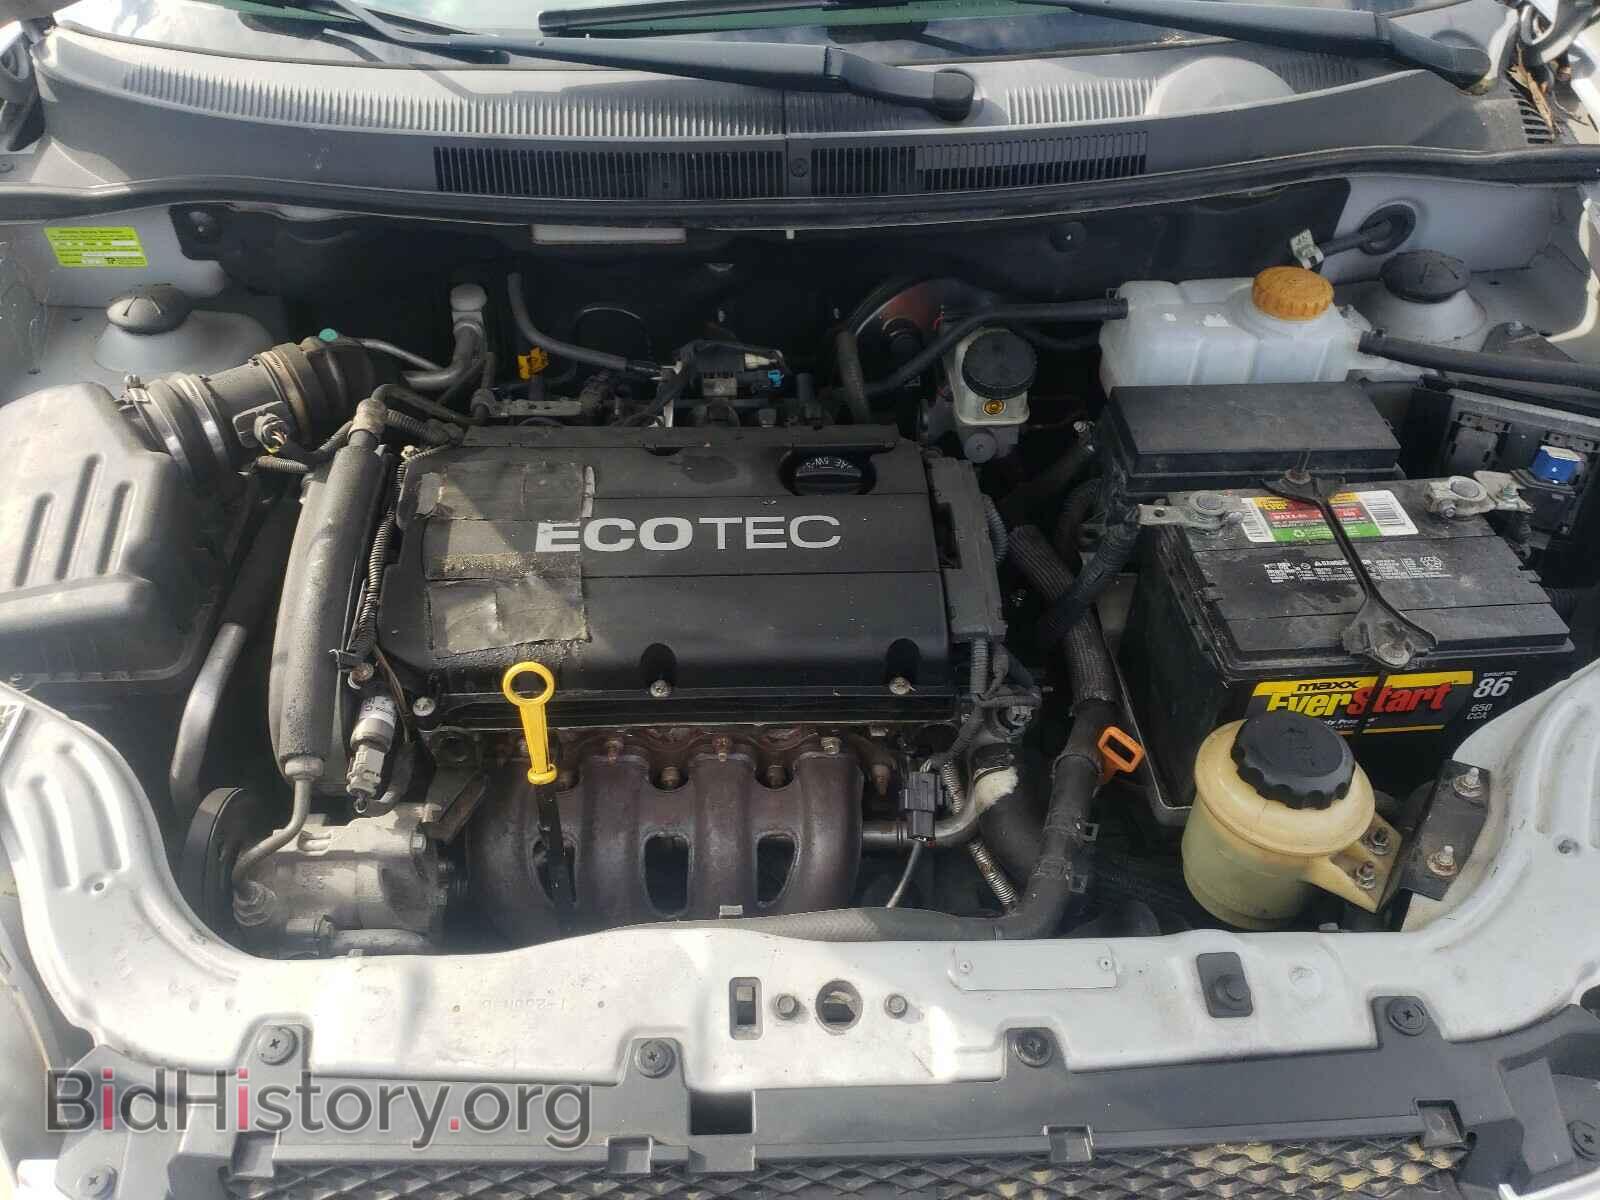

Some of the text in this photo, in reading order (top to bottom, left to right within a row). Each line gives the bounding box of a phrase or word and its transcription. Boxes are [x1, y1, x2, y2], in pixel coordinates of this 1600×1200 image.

[535, 515, 841, 552] ECOTEC
[1296, 680, 1361, 692] maxx
[1473, 677, 1513, 698] 86
[1471, 703, 1493, 712] 650
[1466, 711, 1488, 720] CCA
